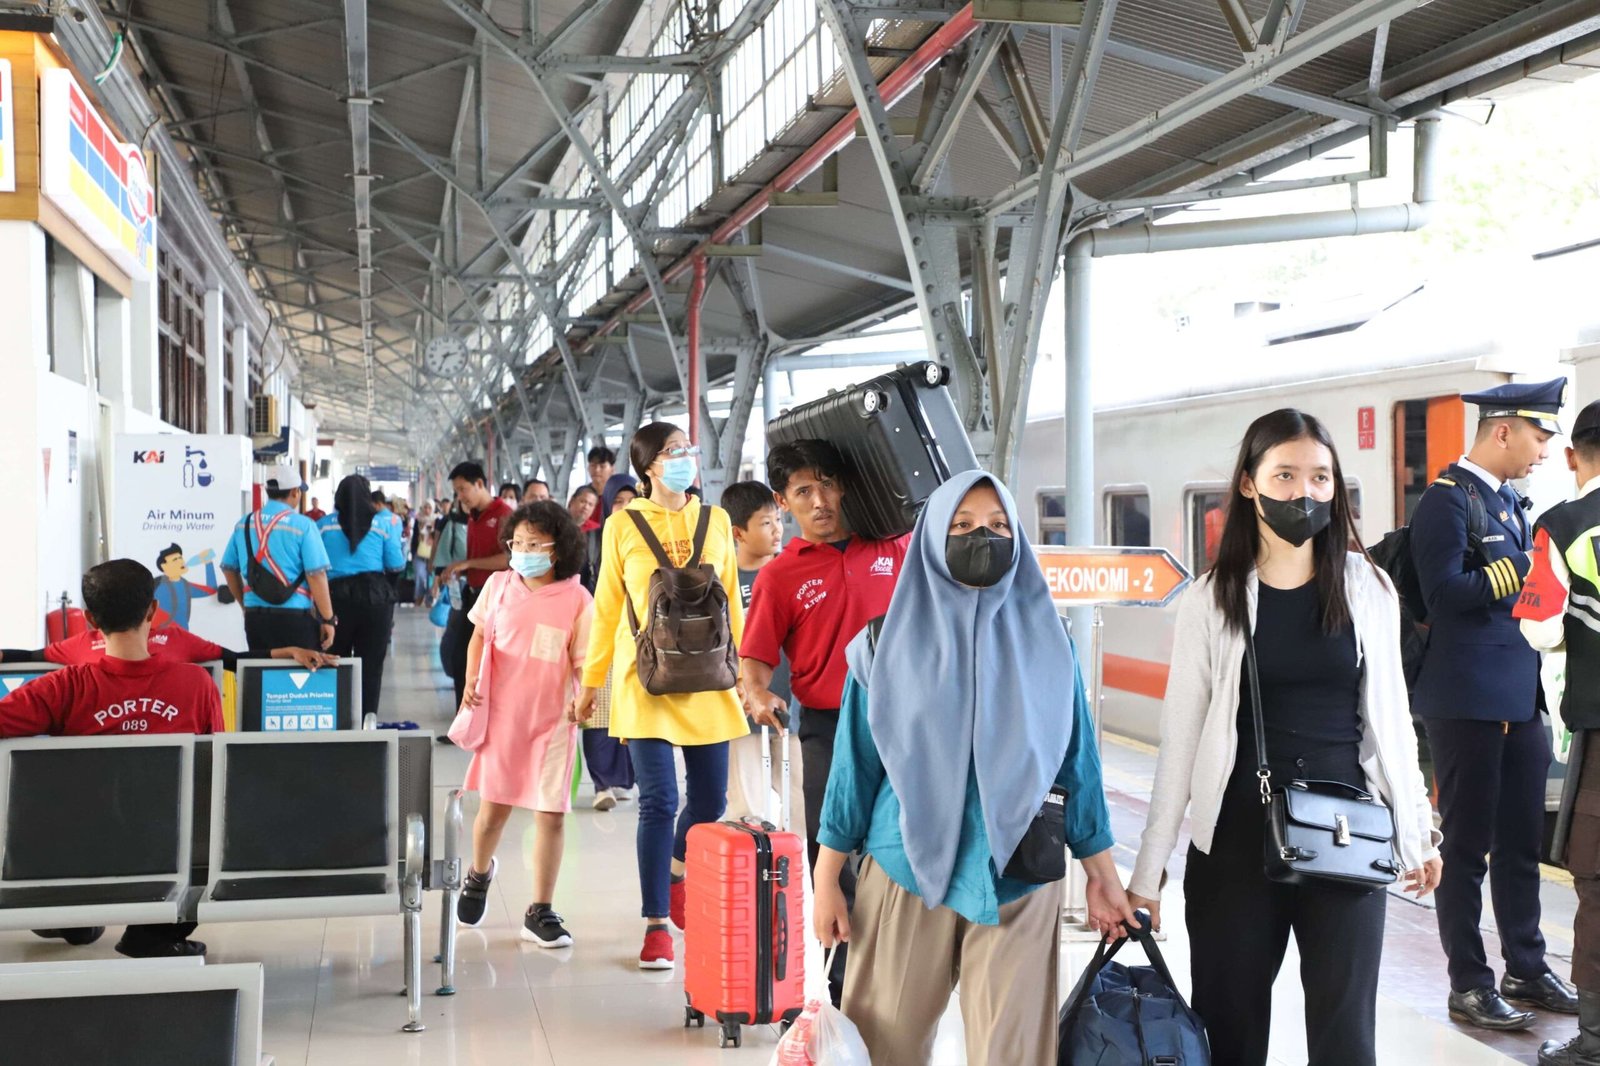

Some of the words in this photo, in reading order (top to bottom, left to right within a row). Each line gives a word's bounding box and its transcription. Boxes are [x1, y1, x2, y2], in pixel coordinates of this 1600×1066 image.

[133, 450, 165, 463] KAI
[147, 510, 166, 520] Air
[170, 510, 214, 520] Minum
[142, 522, 183, 532] Drinking
[186, 522, 215, 531] Water
[878, 556, 894, 566] KAI
[1045, 567, 1129, 593] EKONOMI
[1143, 567, 1154, 593] 2
[796, 579, 823, 600] PORTER
[93, 697, 179, 727] PORTER
[122, 719, 148, 732] 089
